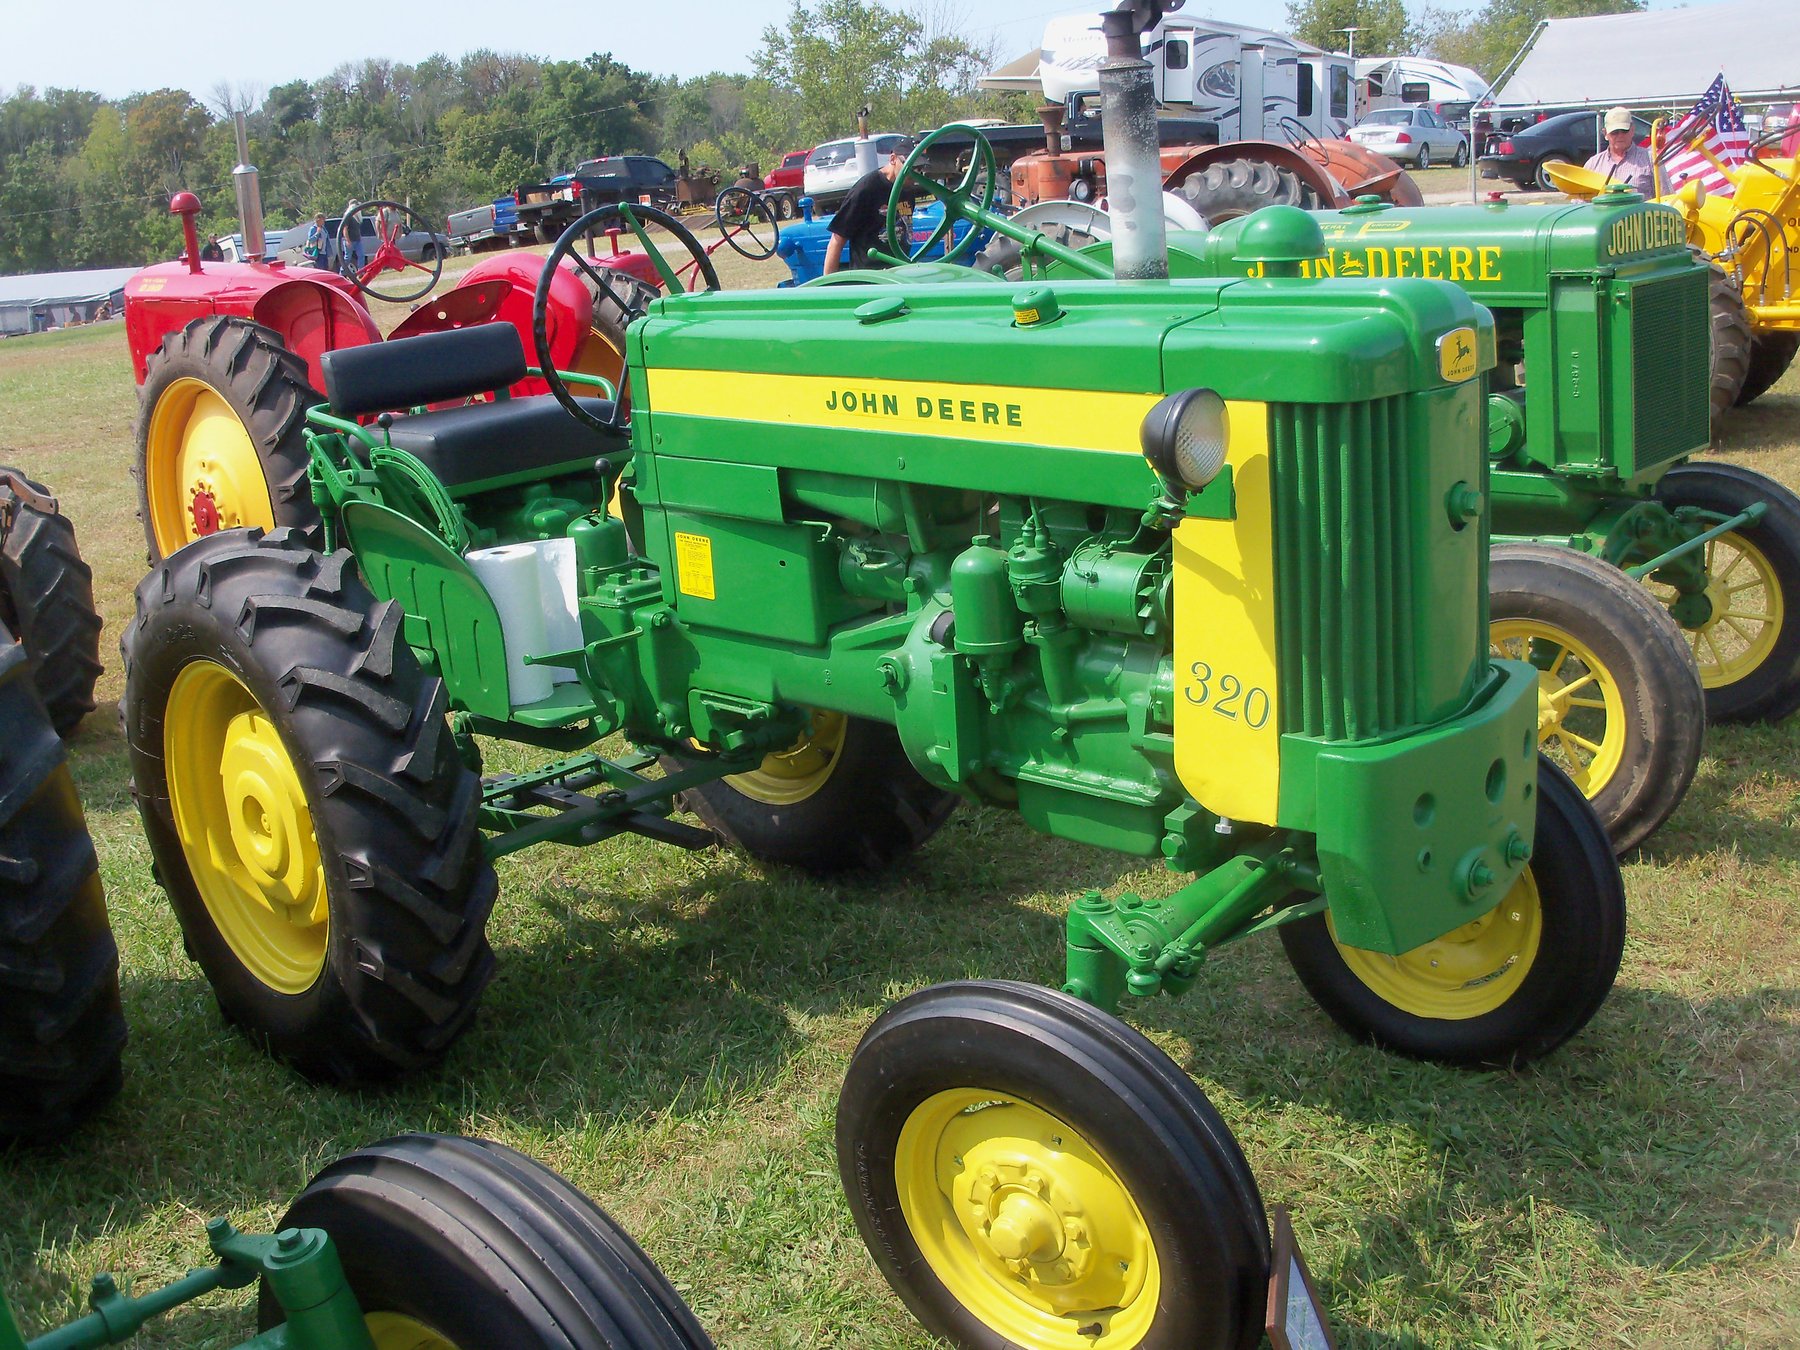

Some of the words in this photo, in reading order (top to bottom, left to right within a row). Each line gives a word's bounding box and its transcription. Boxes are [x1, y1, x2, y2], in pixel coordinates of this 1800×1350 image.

[1607, 212, 1642, 256] JOHN
[1645, 210, 1682, 249] DEERE
[1247, 247, 1335, 279] JN
[1365, 246, 1501, 280] DEERE
[826, 390, 899, 416] JOHN
[916, 396, 1022, 427] DEERE
[1184, 661, 1271, 730] 320
